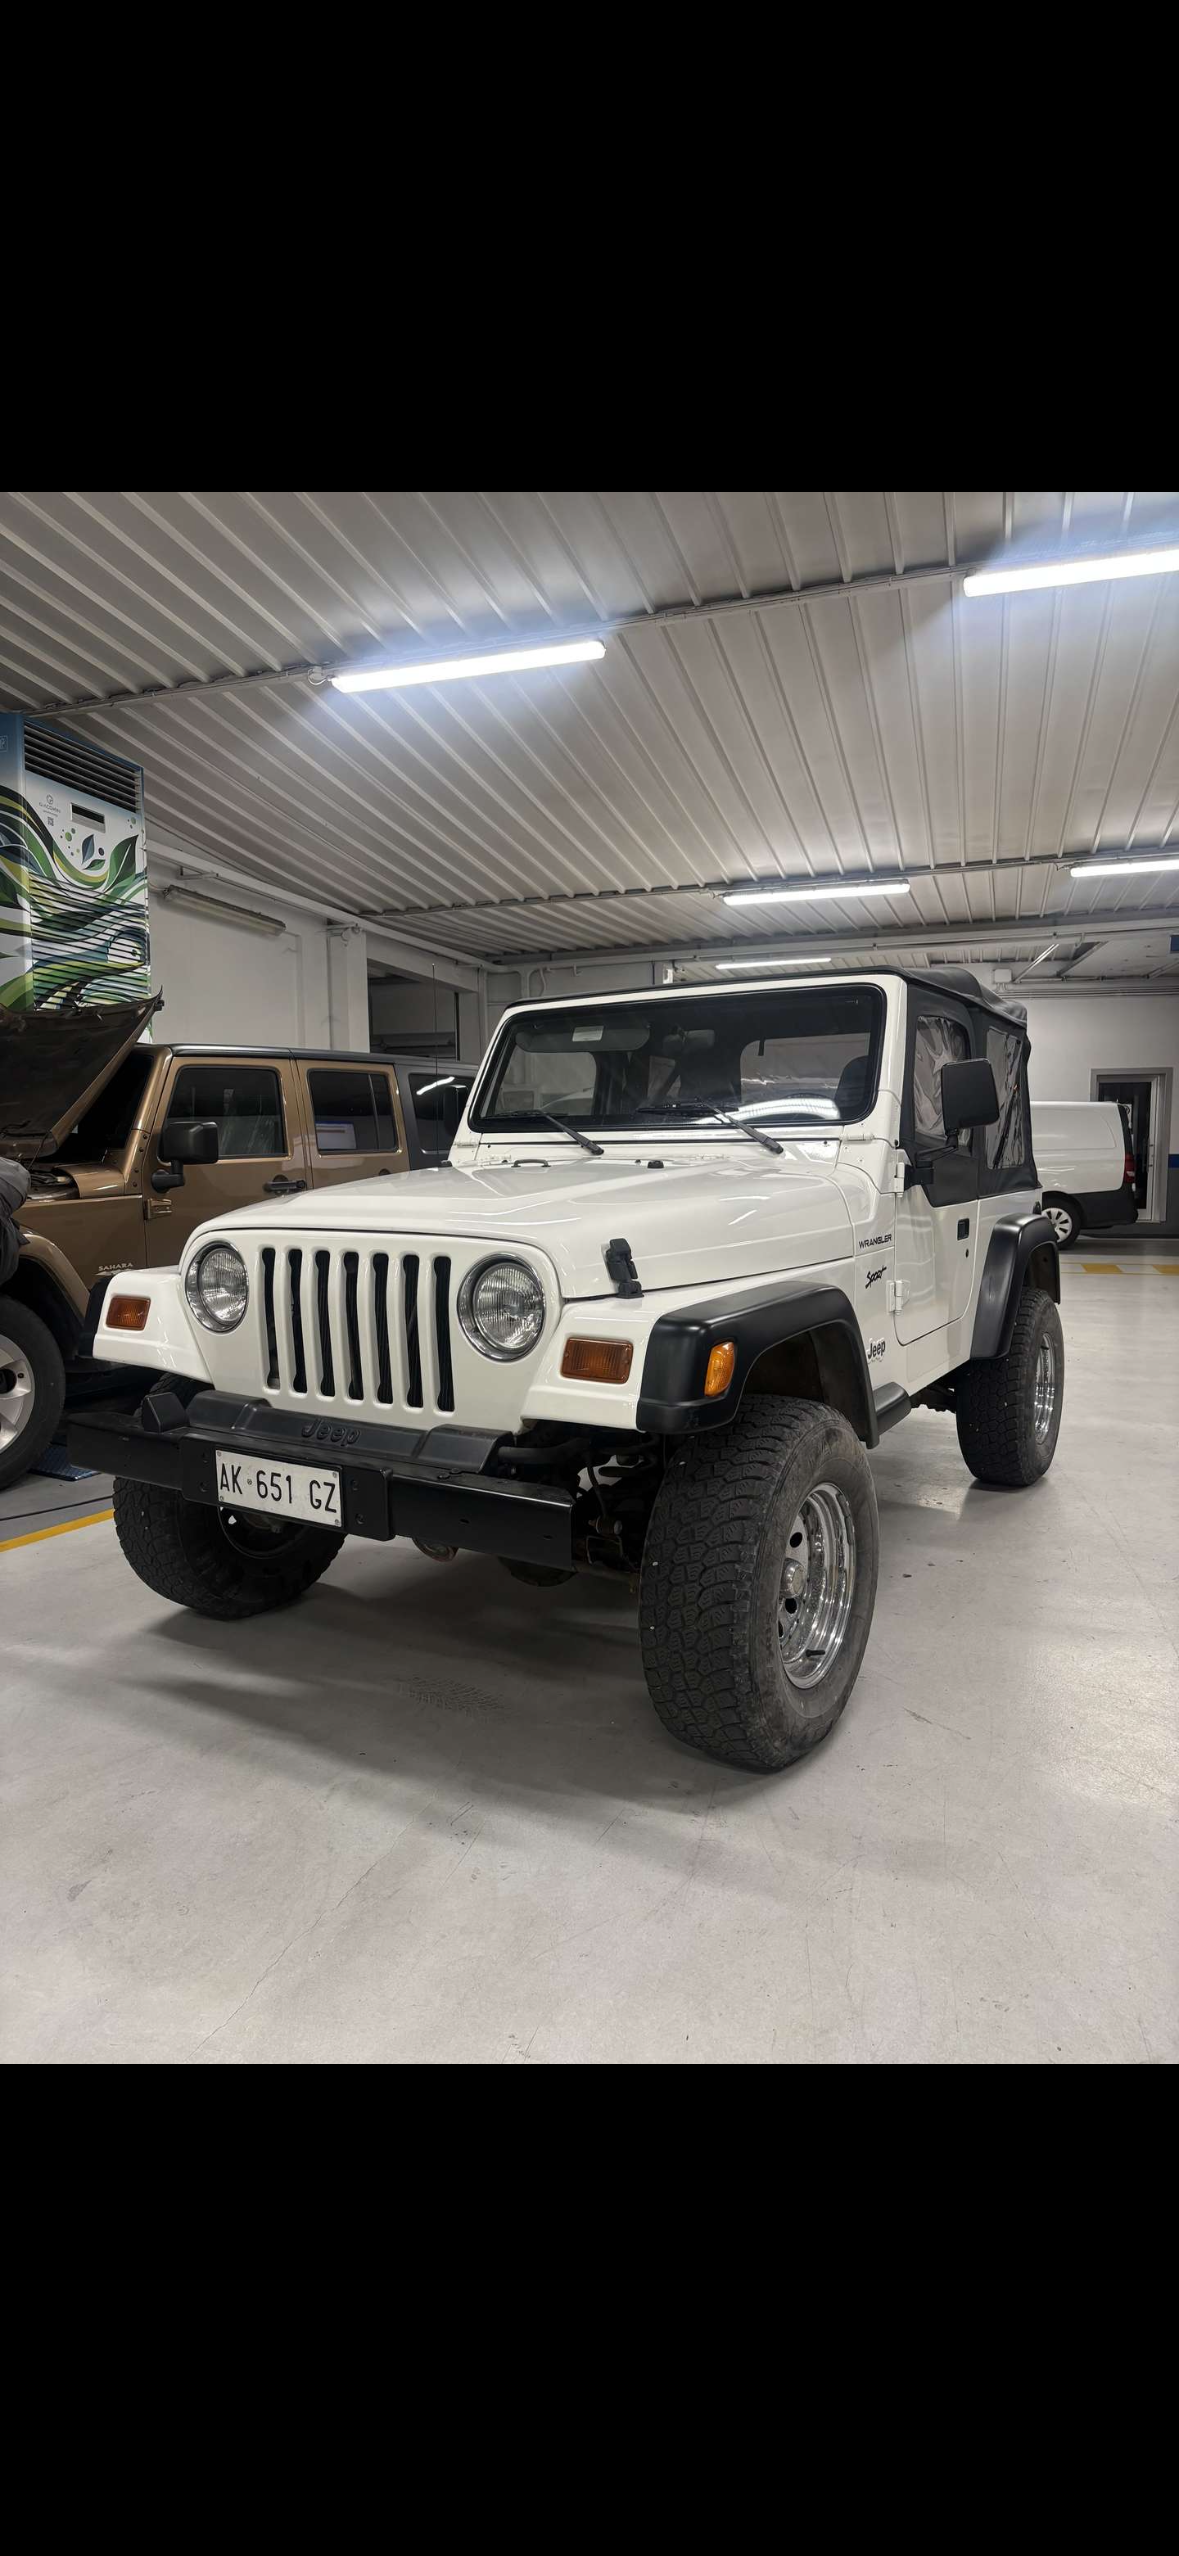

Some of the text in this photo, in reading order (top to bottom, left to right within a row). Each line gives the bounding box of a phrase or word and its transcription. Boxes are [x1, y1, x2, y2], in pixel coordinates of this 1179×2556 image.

[858, 1233, 892, 1249] WRANGLER
[98, 1263, 133, 1271] SAHARA
[867, 1340, 886, 1360] Jeep
[301, 1418, 360, 1447] Jeep
[220, 1463, 337, 1513] AK 651 GZ
